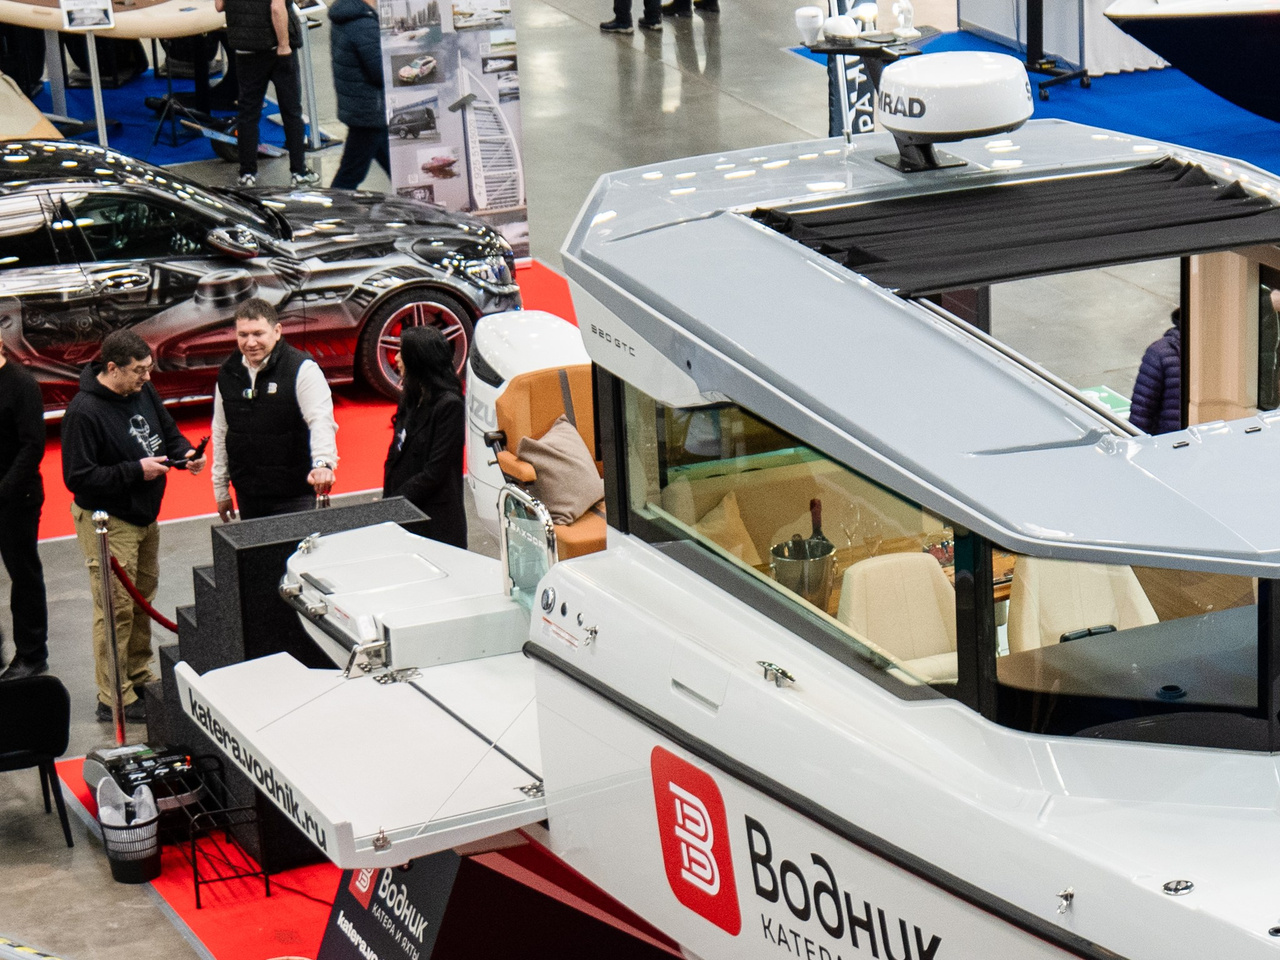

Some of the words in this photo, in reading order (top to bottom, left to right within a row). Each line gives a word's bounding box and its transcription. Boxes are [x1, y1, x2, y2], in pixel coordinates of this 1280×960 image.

[615, 337, 636, 357] GTC
[188, 687, 327, 853] katera.vodnik.ru
[371, 902, 396, 937] КАТЕРА
[395, 929, 402, 943] И
[378, 868, 429, 943] Водник
